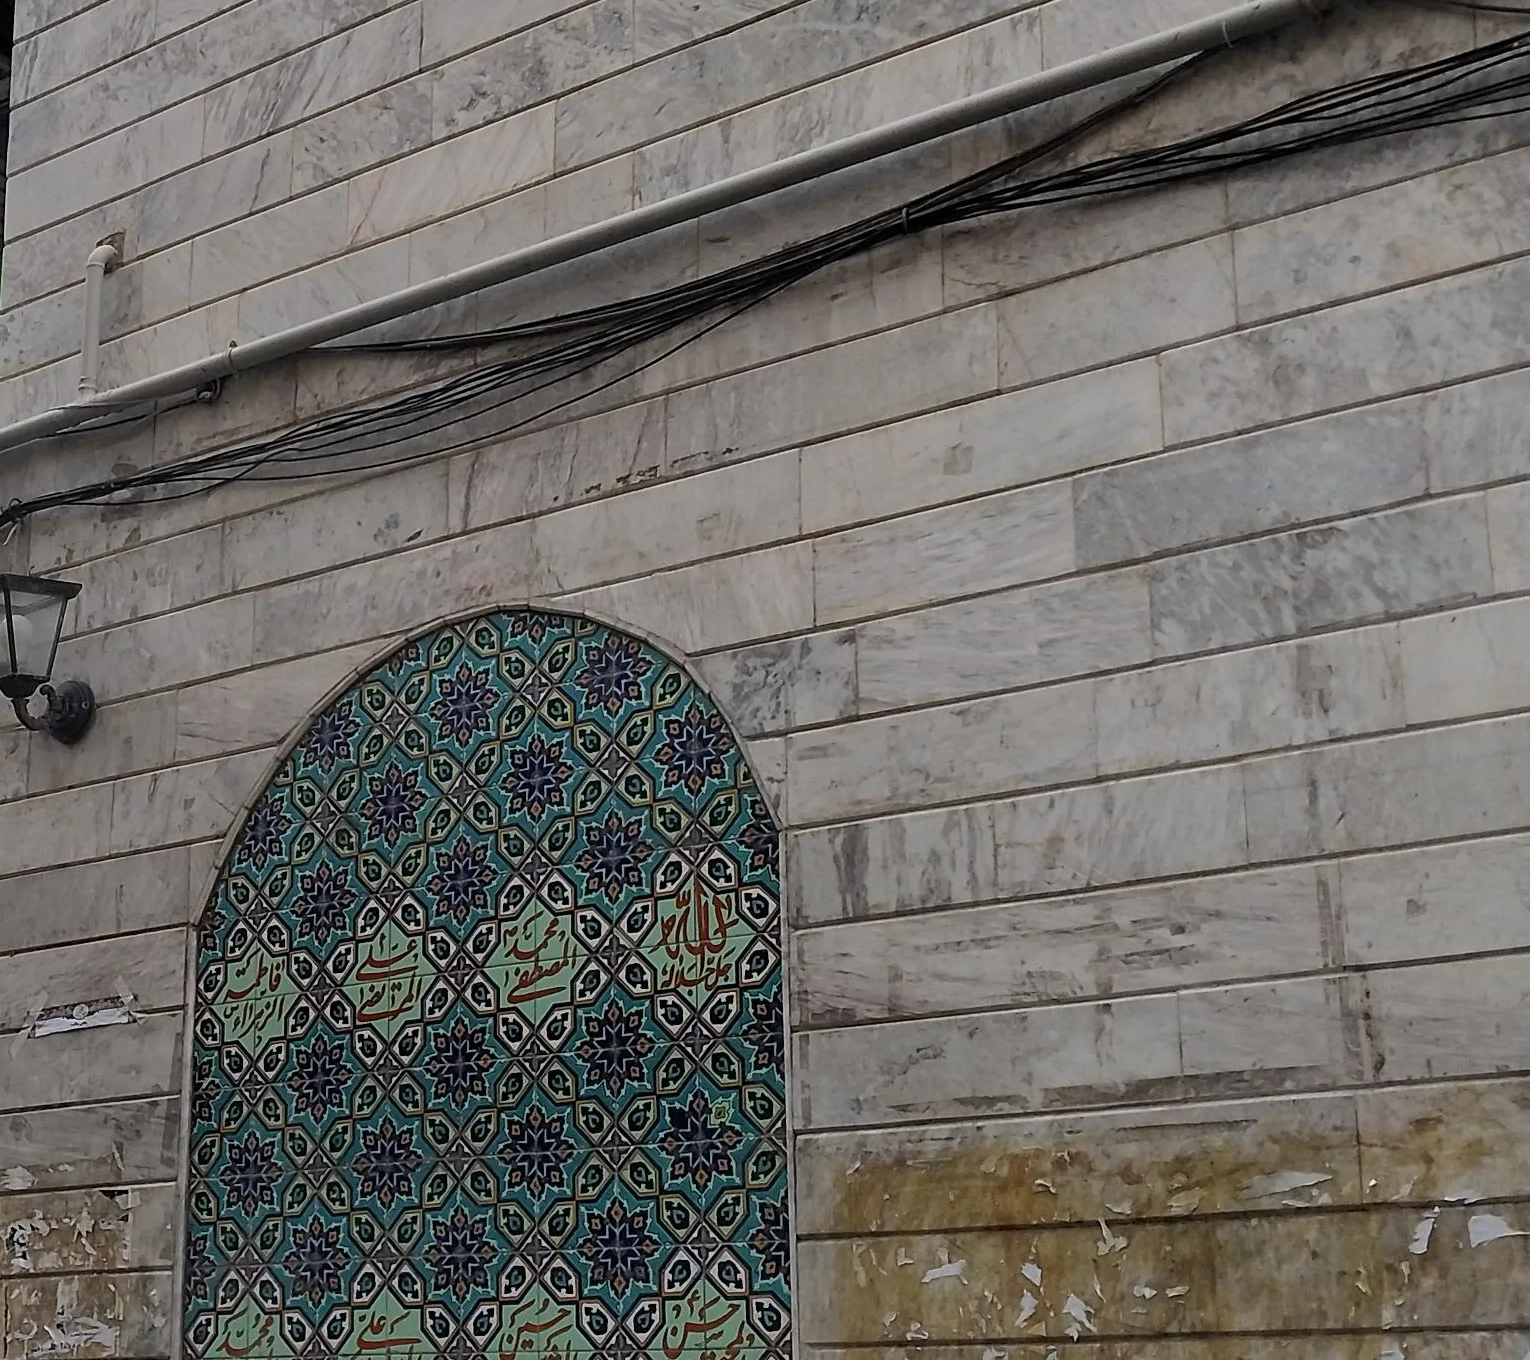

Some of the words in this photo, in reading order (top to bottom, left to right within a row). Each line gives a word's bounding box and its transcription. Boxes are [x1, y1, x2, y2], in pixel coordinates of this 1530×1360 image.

[504, 915, 561, 962] محمد
[647, 876, 740, 961] الله
[355, 937, 420, 982] علی
[215, 1309, 276, 1358] محمد
[356, 1309, 423, 1352] علی
[661, 1295, 742, 1360] حسن
